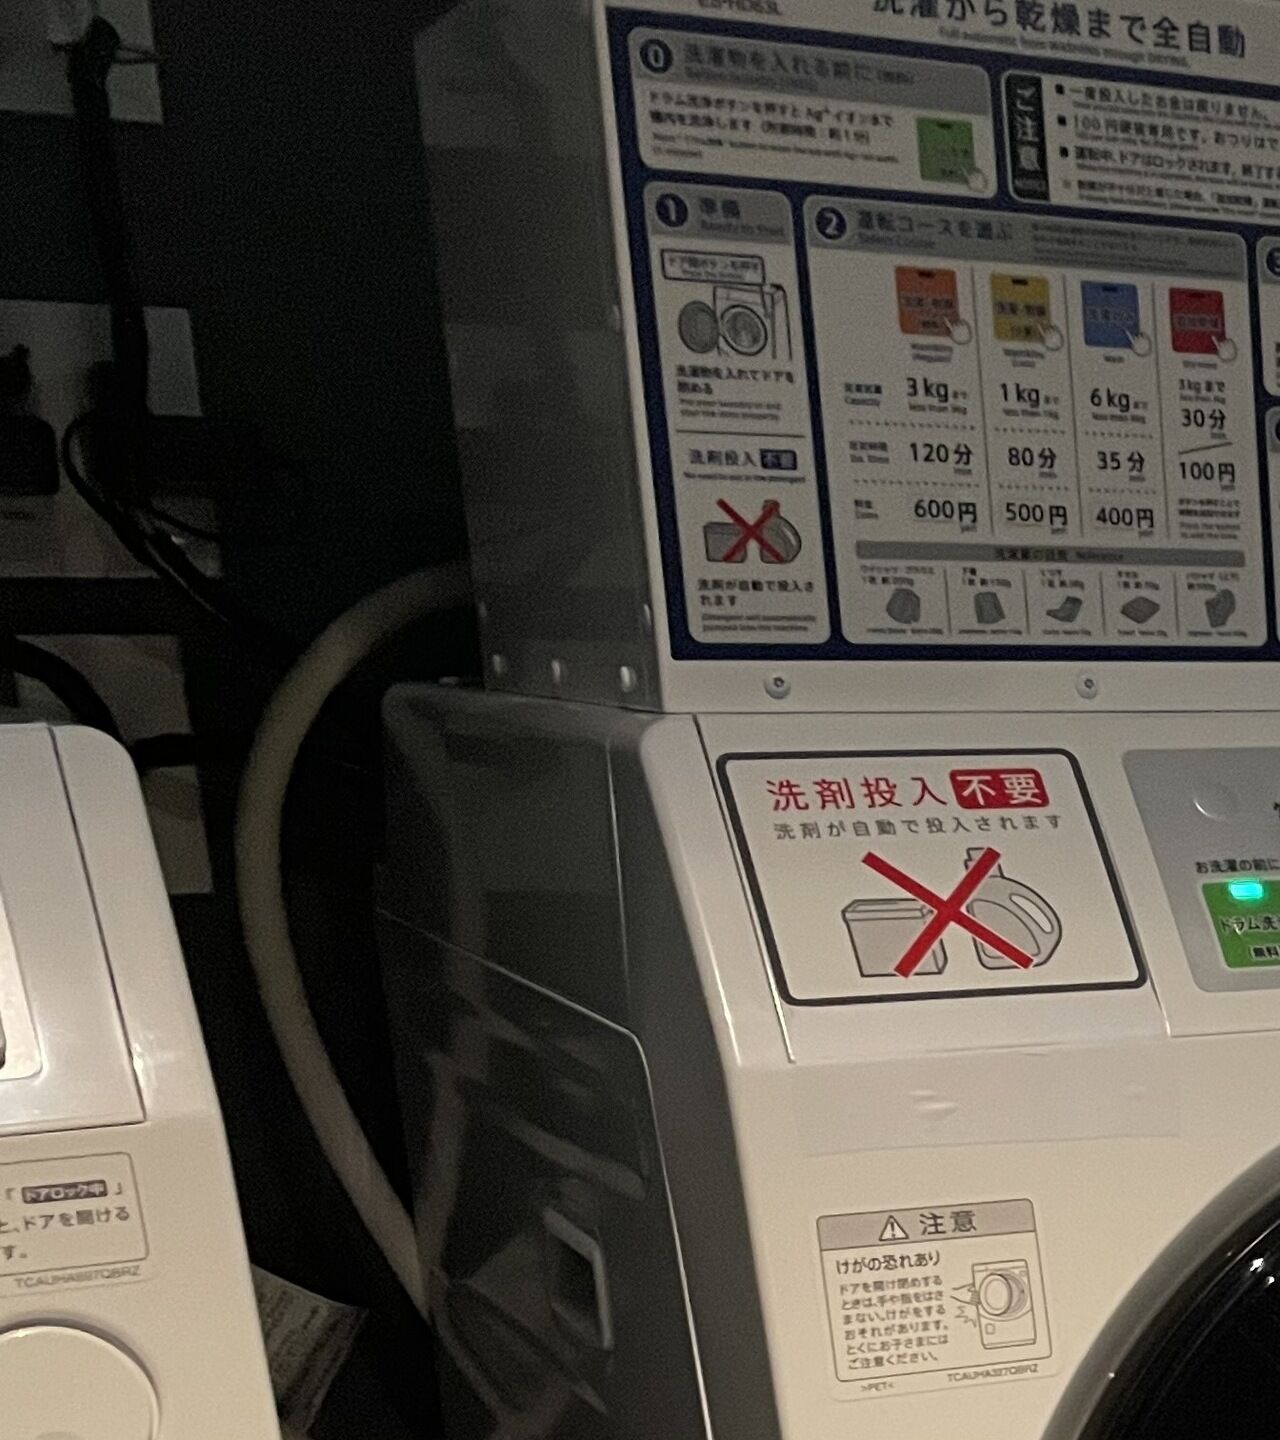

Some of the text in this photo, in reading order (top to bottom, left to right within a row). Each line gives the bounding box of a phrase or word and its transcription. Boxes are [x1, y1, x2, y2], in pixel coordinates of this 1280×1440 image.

[1182, 409, 1226, 431] 30分
[910, 442, 974, 467] 120分
[1007, 447, 1058, 470] 80分
[1096, 451, 1146, 473] 35分
[1179, 461, 1236, 485] 100円
[913, 498, 978, 525] 600円
[1004, 502, 1069, 527] 500円
[1095, 507, 1155, 530] 400円
[765, 772, 1044, 812] 洗剤投入 不要
[773, 813, 1062, 841] 洗剤が自動で投入されます
[919, 1209, 978, 1237] 注意
[836, 1249, 941, 1275] けがの恐れあり
